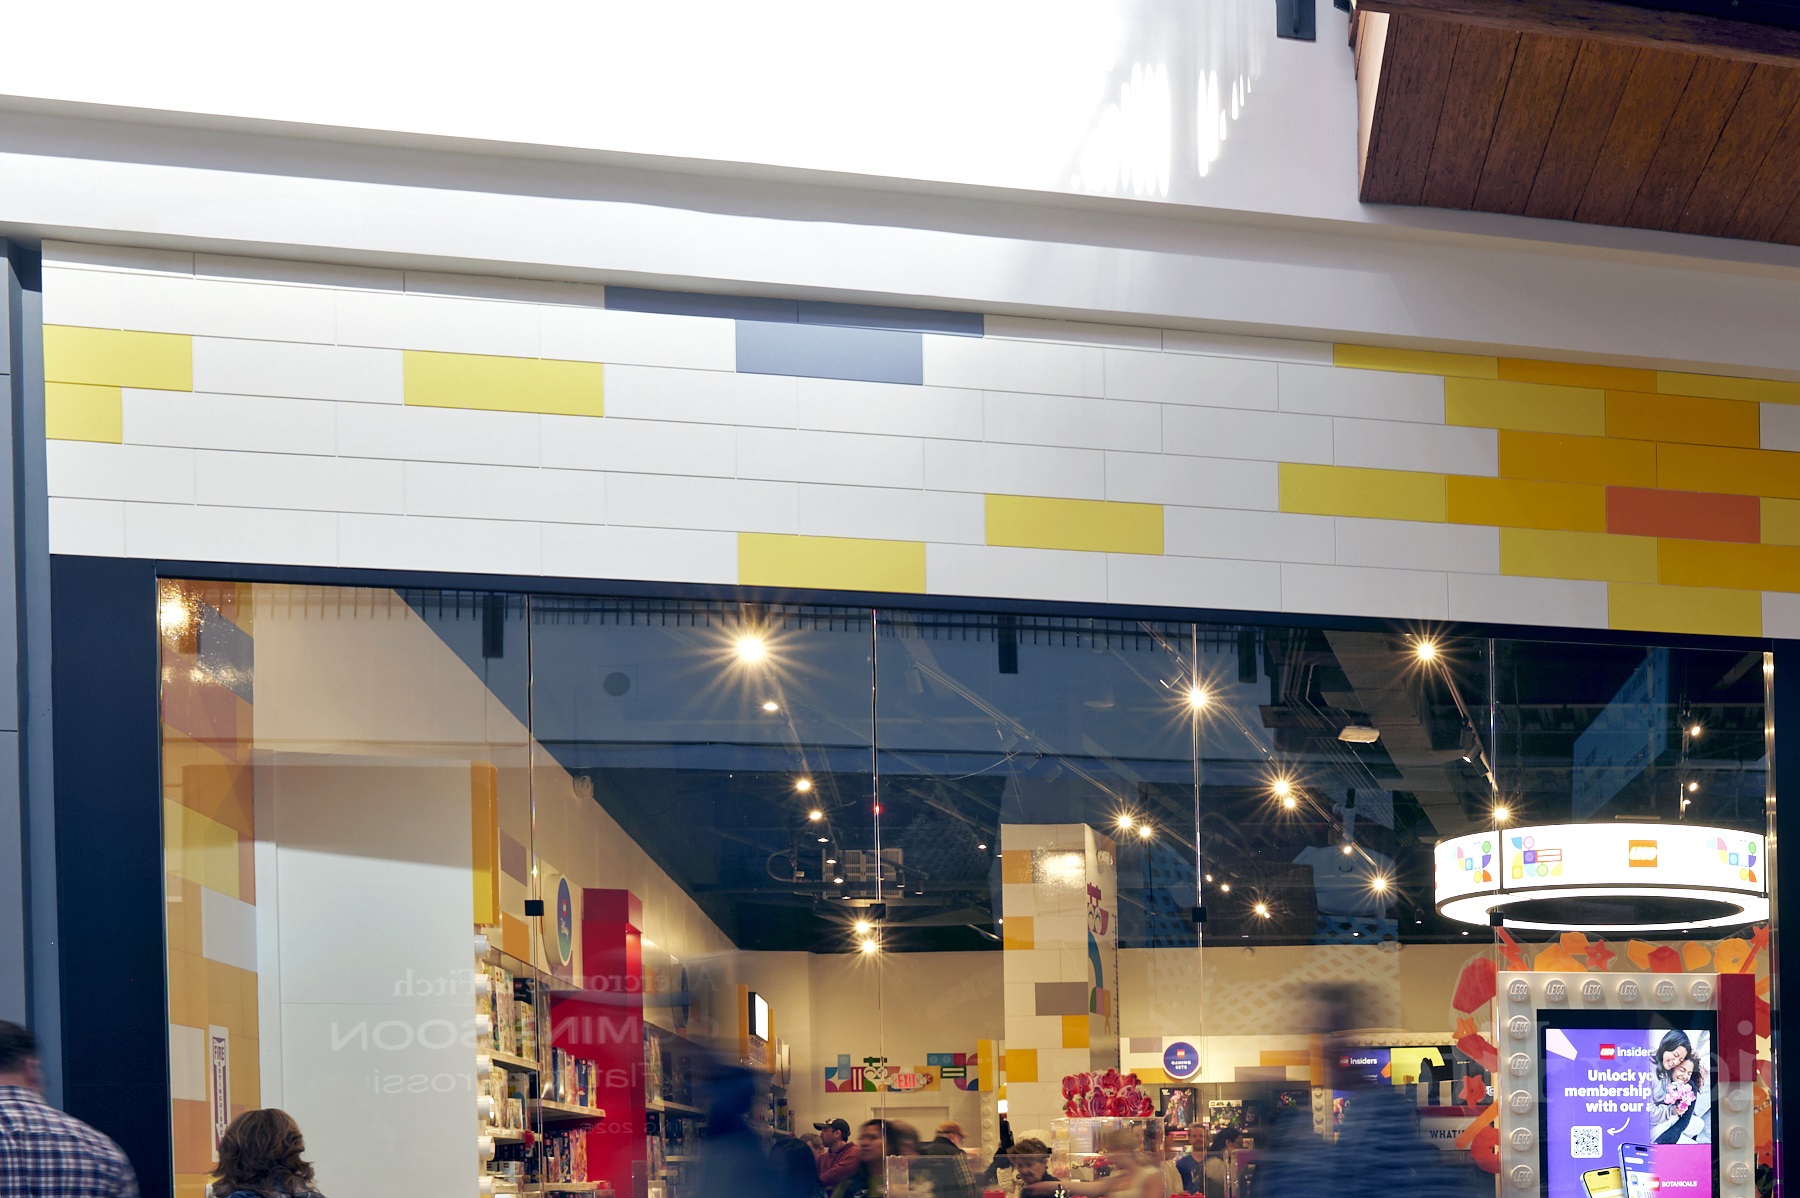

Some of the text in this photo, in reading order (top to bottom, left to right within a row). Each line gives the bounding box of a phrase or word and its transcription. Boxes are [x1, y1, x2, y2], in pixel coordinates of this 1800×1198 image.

[1510, 984, 1527, 995] LEGO
[1547, 984, 1564, 995] LEGO
[1584, 985, 1601, 995] LEGO
[1620, 985, 1638, 996] LEGO
[1657, 985, 1674, 996] LEGO
[1511, 1021, 1528, 1032] LEGO
[1512, 1058, 1529, 1070] LEGO
[897, 1073, 916, 1088] EXIT
[1588, 1069, 1636, 1081] Unlock
[1564, 1084, 1651, 1099] membership
[1512, 1096, 1529, 1107] LEGO
[1586, 1099, 1617, 1112] with
[1620, 1103, 1644, 1112] our
[1513, 1133, 1530, 1144] LEGO
[1514, 1171, 1531, 1181] LEGO
